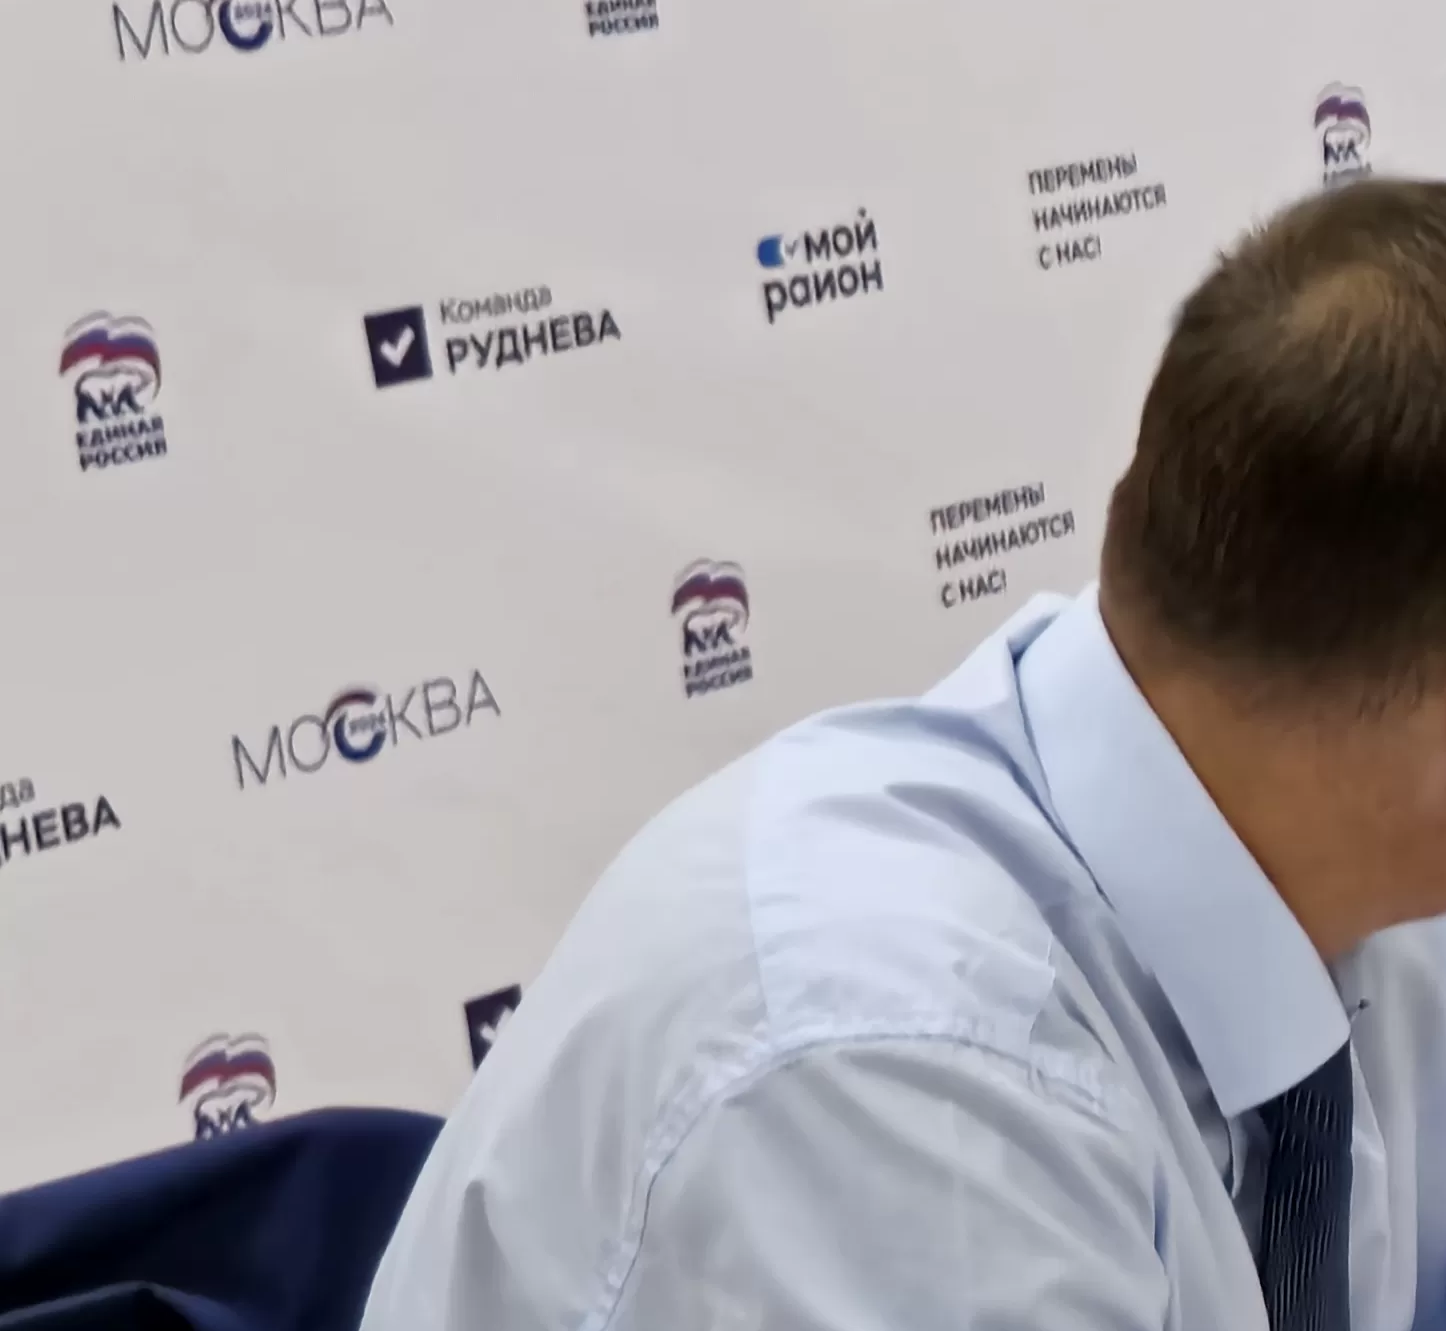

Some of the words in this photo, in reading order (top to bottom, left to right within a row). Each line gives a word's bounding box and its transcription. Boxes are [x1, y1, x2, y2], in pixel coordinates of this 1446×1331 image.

[803, 206, 878, 264] мой
[439, 285, 553, 325] Команда
[762, 260, 884, 324] район
[444, 309, 622, 374] РУДНЕВА
[232, 669, 501, 790] МОСКВА
